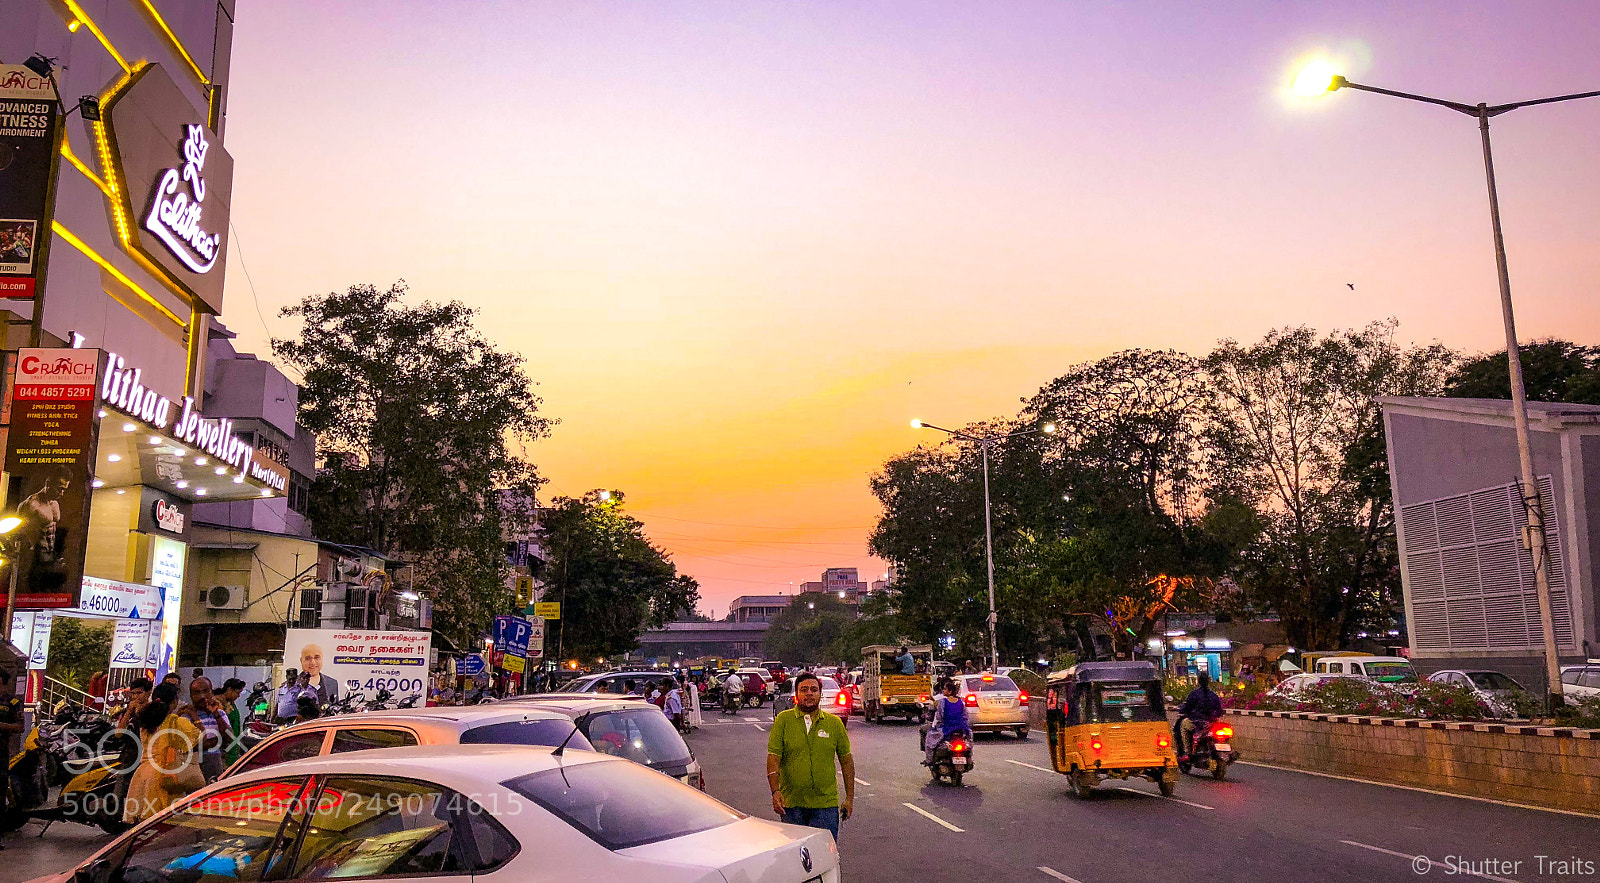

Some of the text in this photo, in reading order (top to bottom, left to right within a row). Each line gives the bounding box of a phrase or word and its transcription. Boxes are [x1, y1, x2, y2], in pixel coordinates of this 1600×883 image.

[21, 356, 95, 375] CRUNCH
[20, 387, 91, 397] 044 4857 5291
[175, 395, 253, 479] Jewellery
[515, 624, 525, 641] P
[336, 644, 365, 654] வைர
[369, 643, 415, 656] நகைகள்
